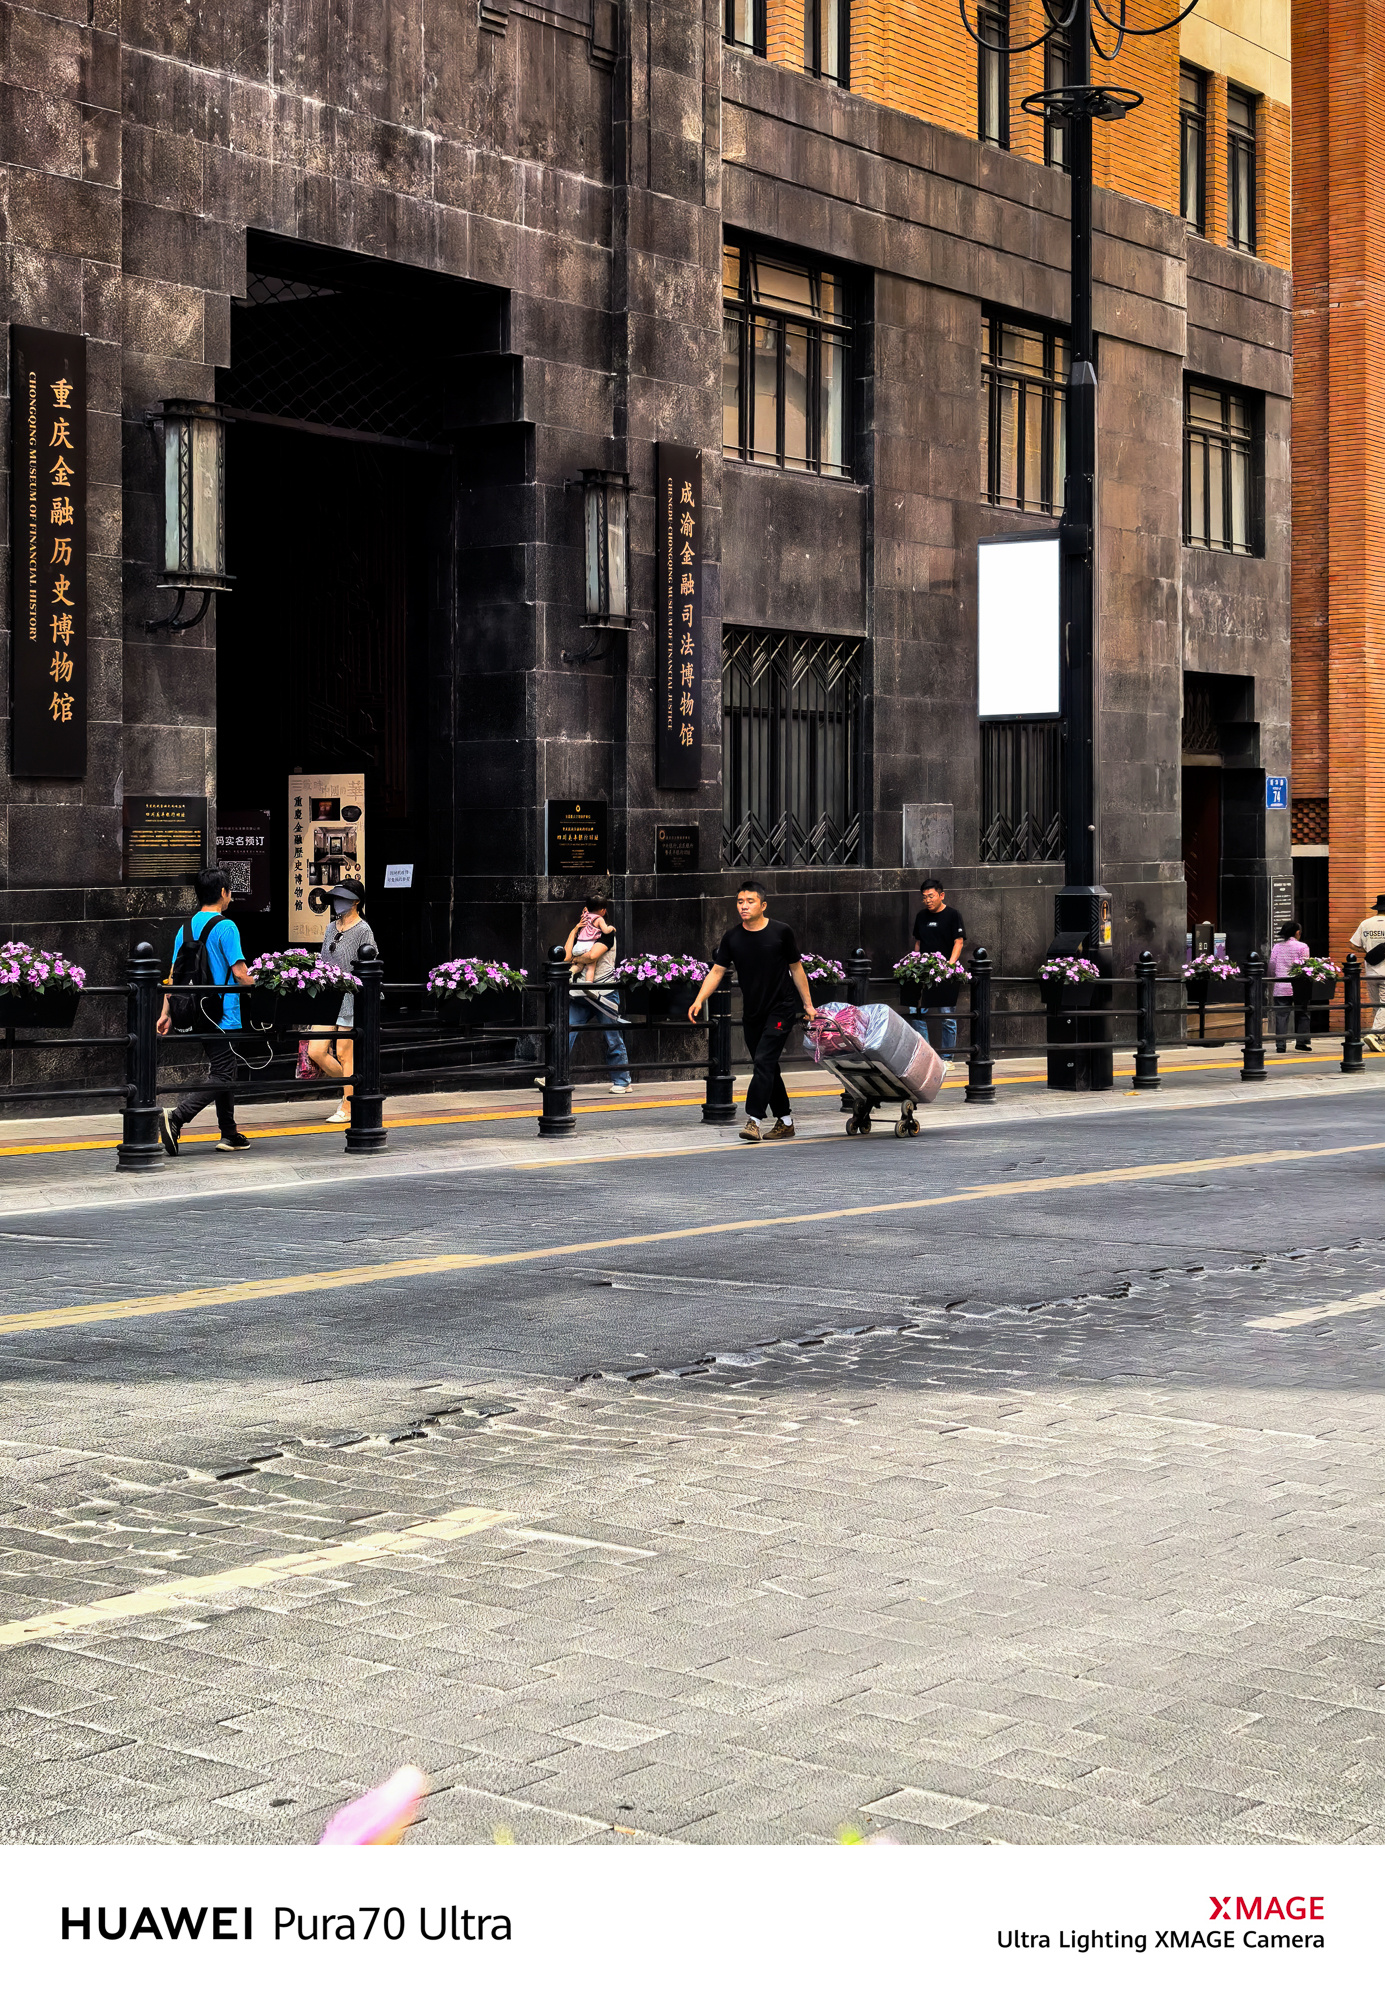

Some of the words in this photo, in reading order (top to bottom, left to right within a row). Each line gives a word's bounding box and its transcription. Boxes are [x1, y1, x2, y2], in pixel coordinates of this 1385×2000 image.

[28, 371, 37, 446] CHONGQING
[29, 448, 37, 502] MUSEUM
[29, 504, 37, 521] OF
[29, 523, 37, 587] FINANCIAL
[49, 377, 75, 723] 重庆金融历史博物馆
[29, 589, 37, 642] HISTORY
[667, 628, 674, 641] OF
[679, 480, 696, 747] 成渝金融司法博物馆
[1273, 791, 1281, 803] 74
